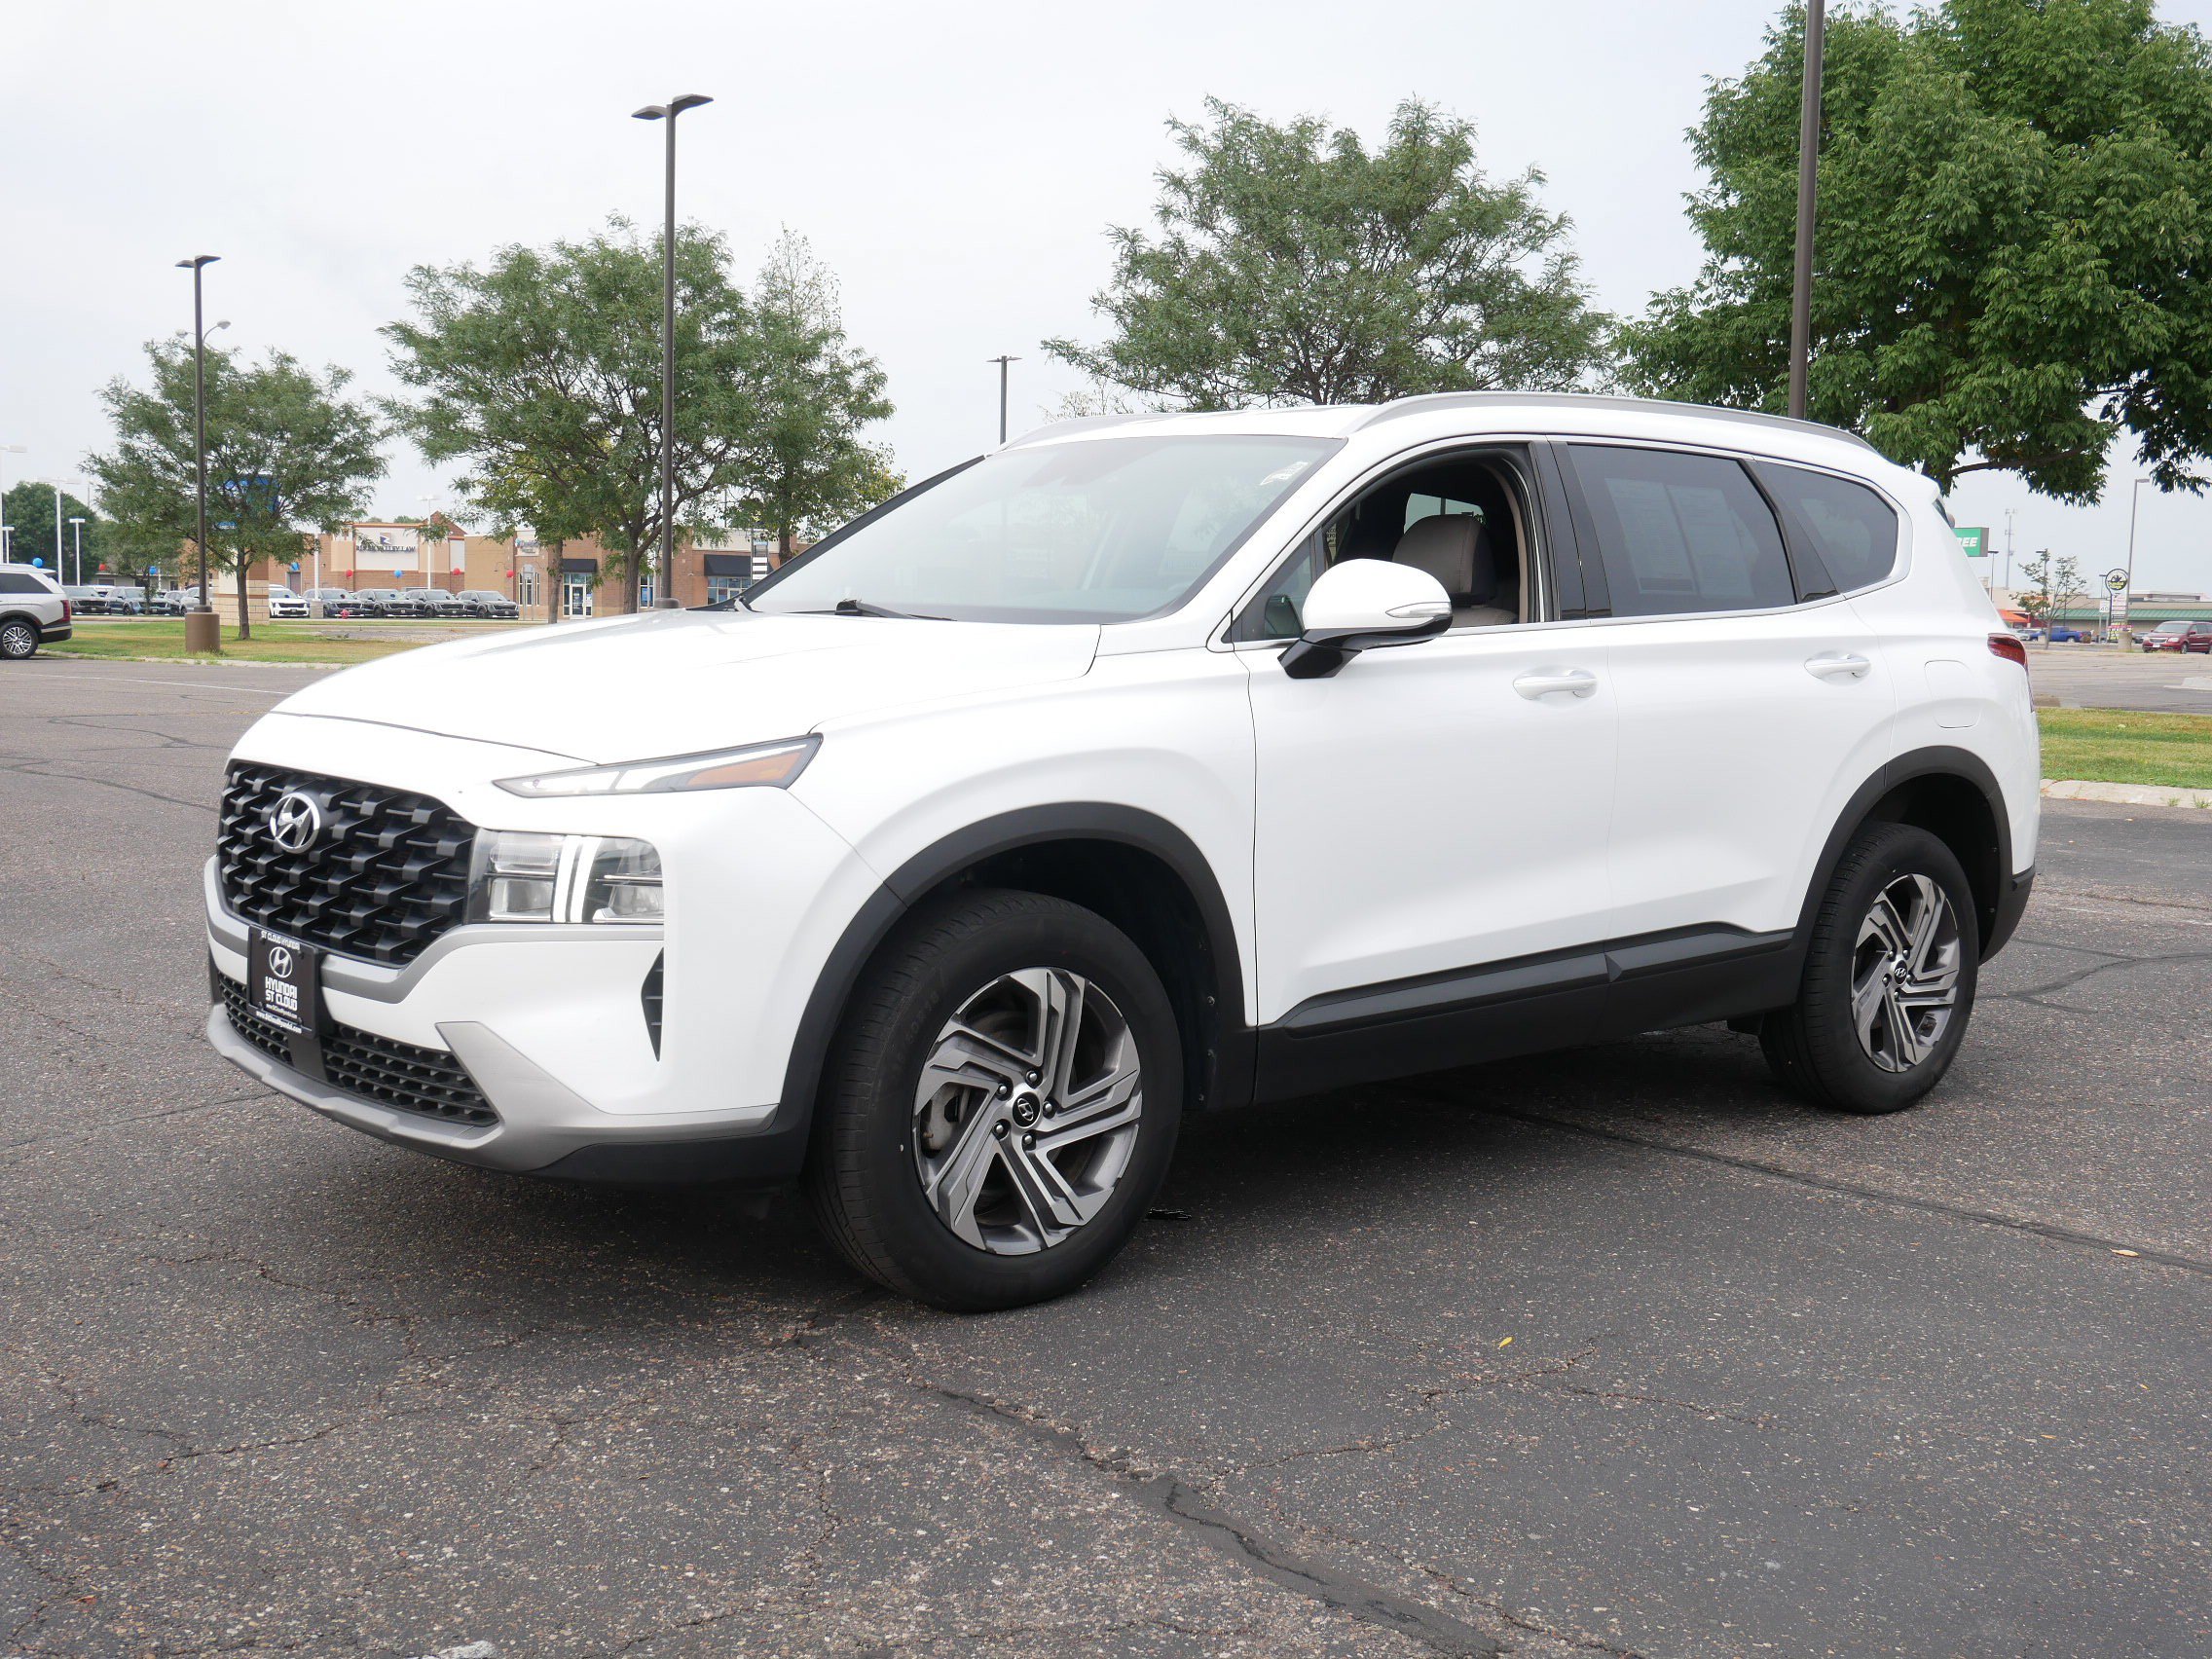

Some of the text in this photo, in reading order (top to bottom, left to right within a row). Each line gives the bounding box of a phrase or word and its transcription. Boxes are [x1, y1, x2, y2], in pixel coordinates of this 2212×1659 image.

[265, 976, 297, 999] HYUNDAI
[265, 988, 297, 1011] ST CLOUD
